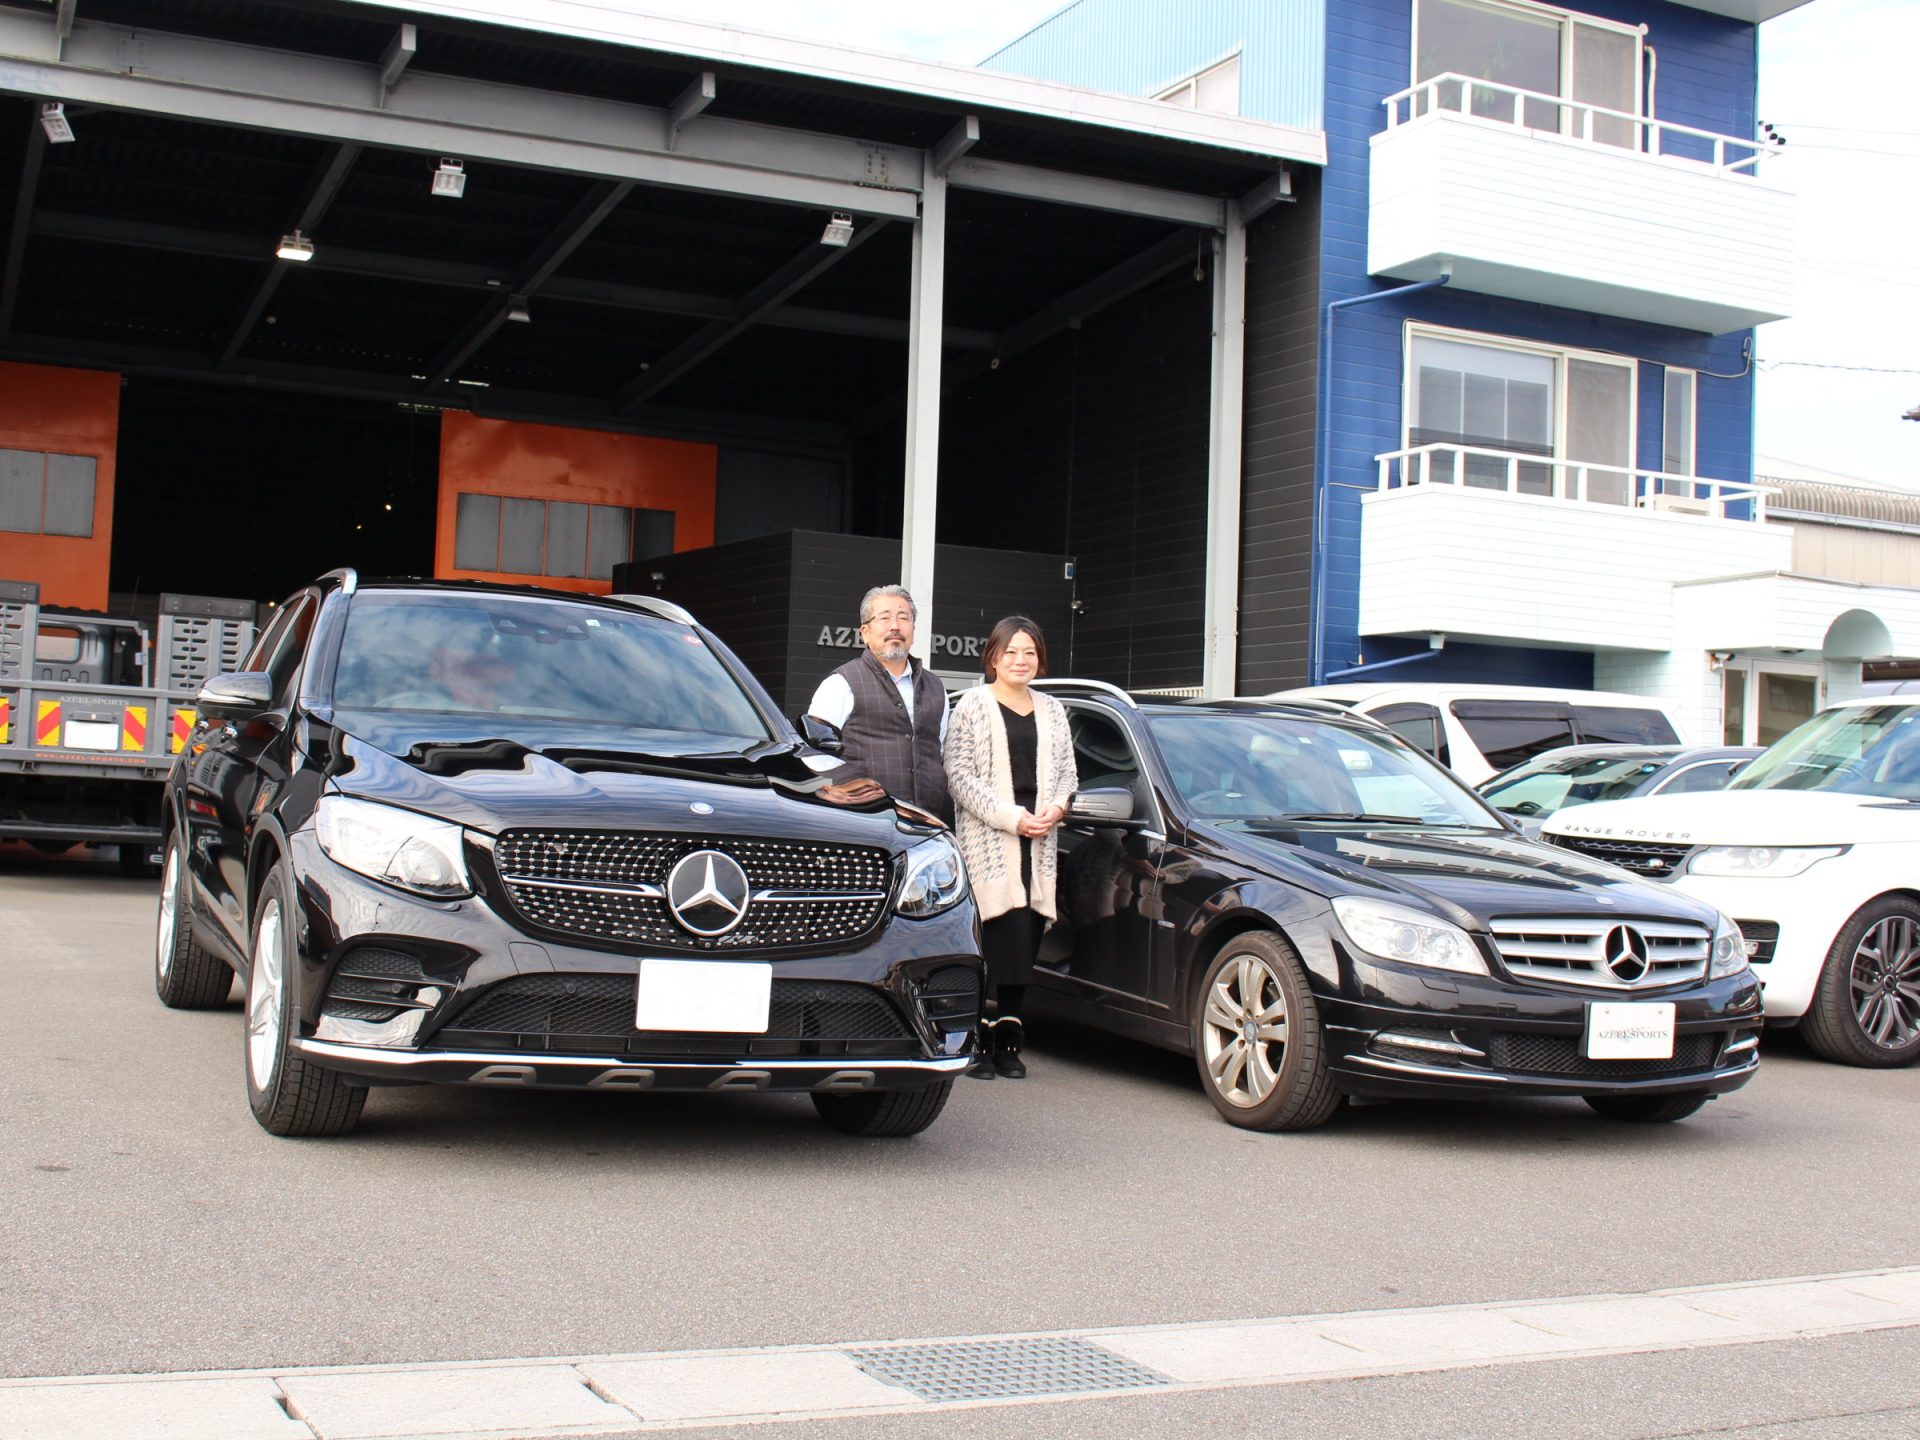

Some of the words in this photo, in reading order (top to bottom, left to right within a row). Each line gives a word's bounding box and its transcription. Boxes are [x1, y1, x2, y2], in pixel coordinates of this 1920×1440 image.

[817, 625, 867, 648] AZE
[931, 633, 989, 657] PORT
[1564, 825, 1613, 835] RANGE
[1624, 829, 1692, 839] ROVER
